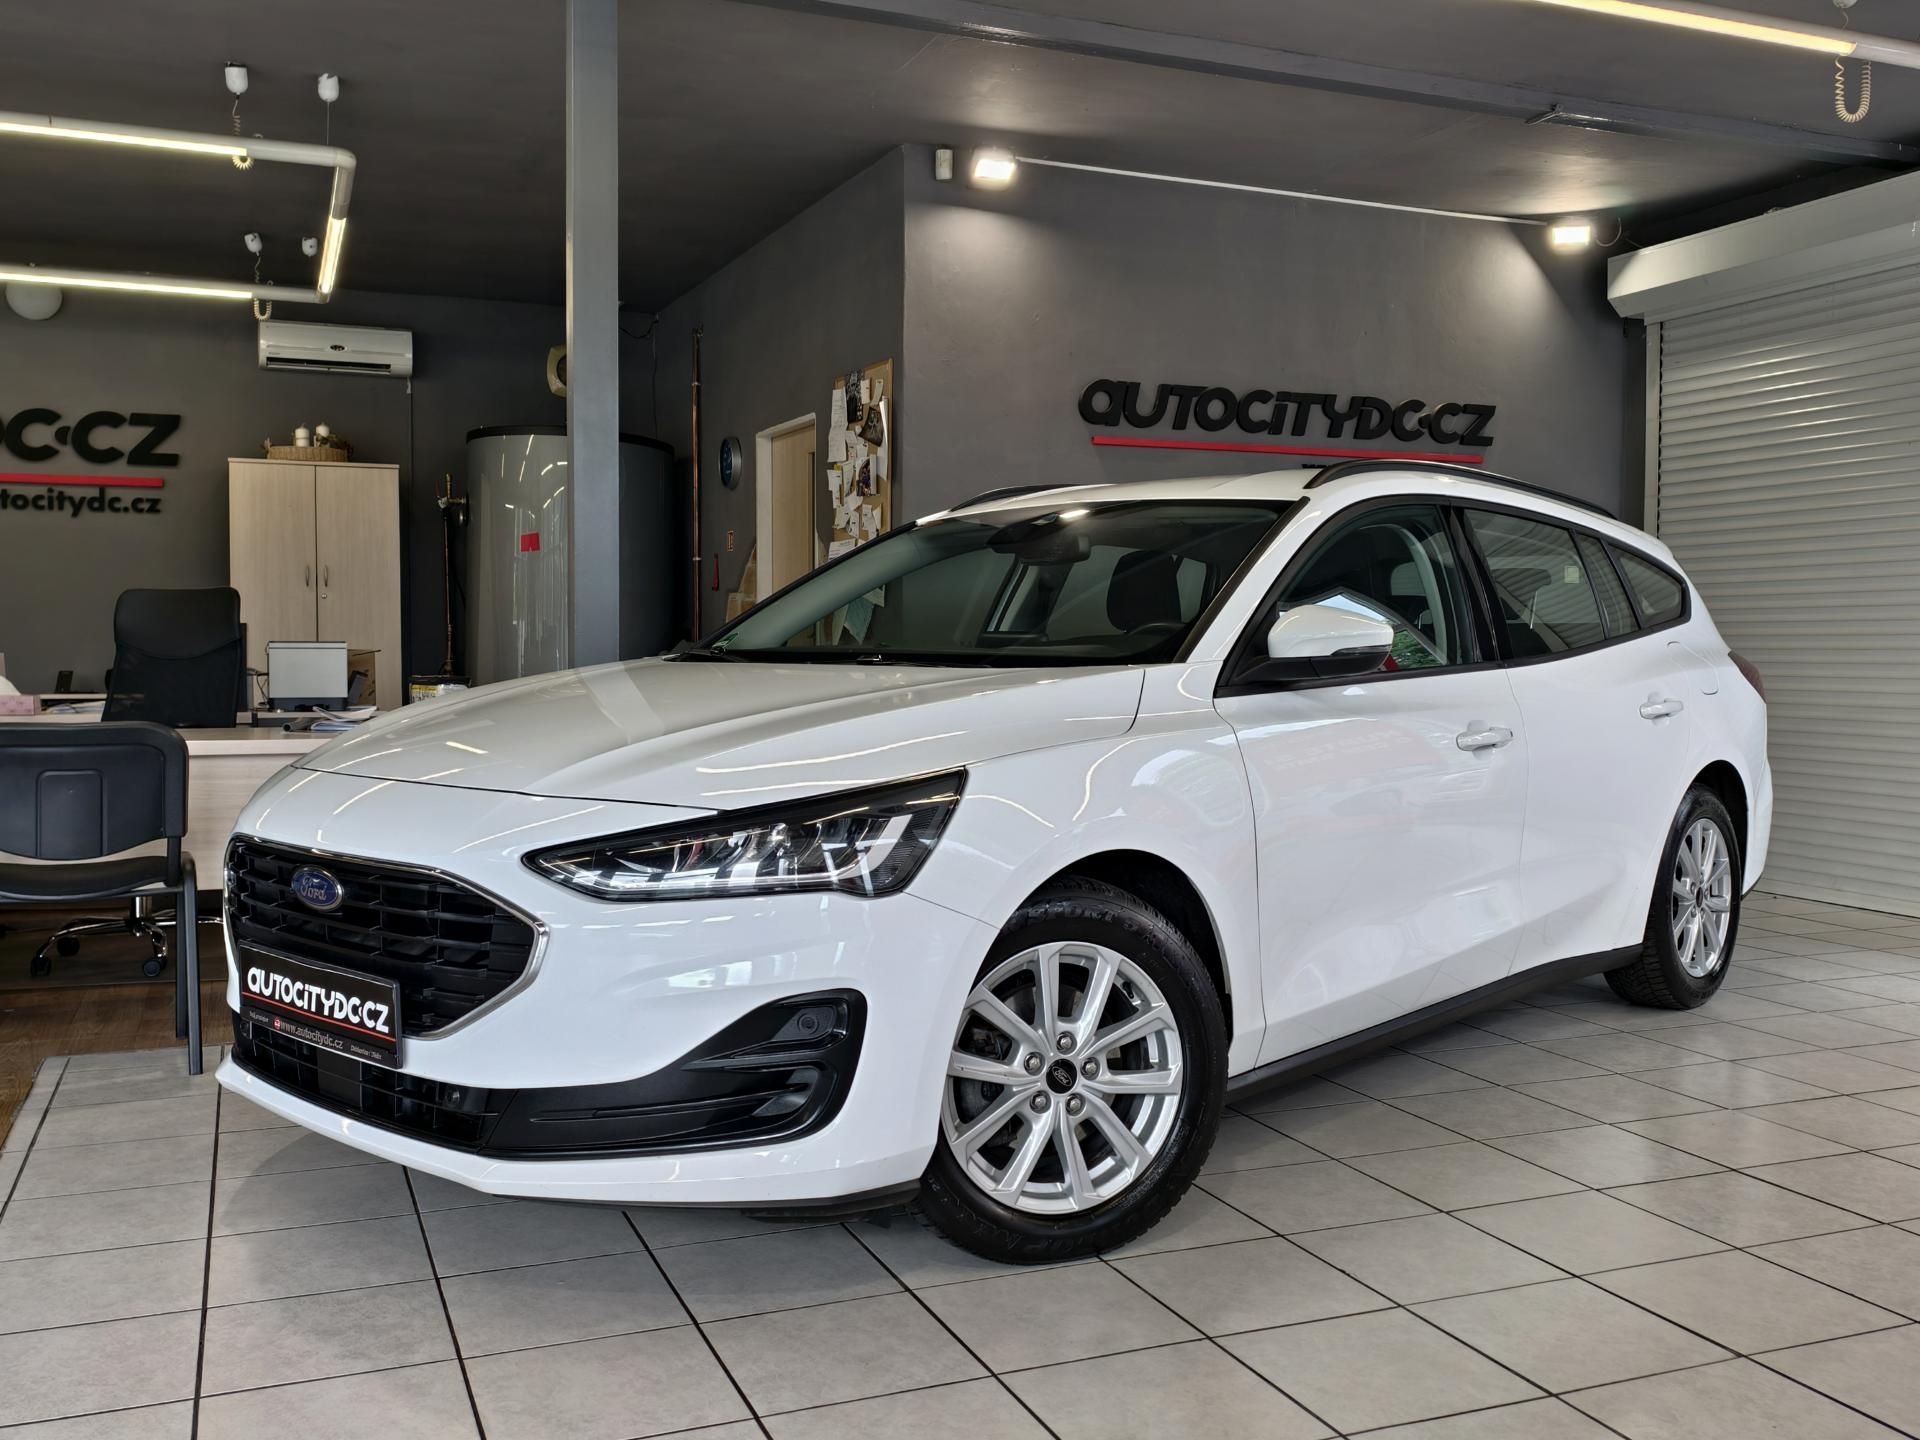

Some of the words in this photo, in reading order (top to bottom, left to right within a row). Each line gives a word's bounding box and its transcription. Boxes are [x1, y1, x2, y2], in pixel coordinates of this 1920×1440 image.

[0, 408, 181, 466] C.CZ
[300, 876, 328, 901] Ford
[281, 1020, 343, 1049] www.autocitydc.cz
